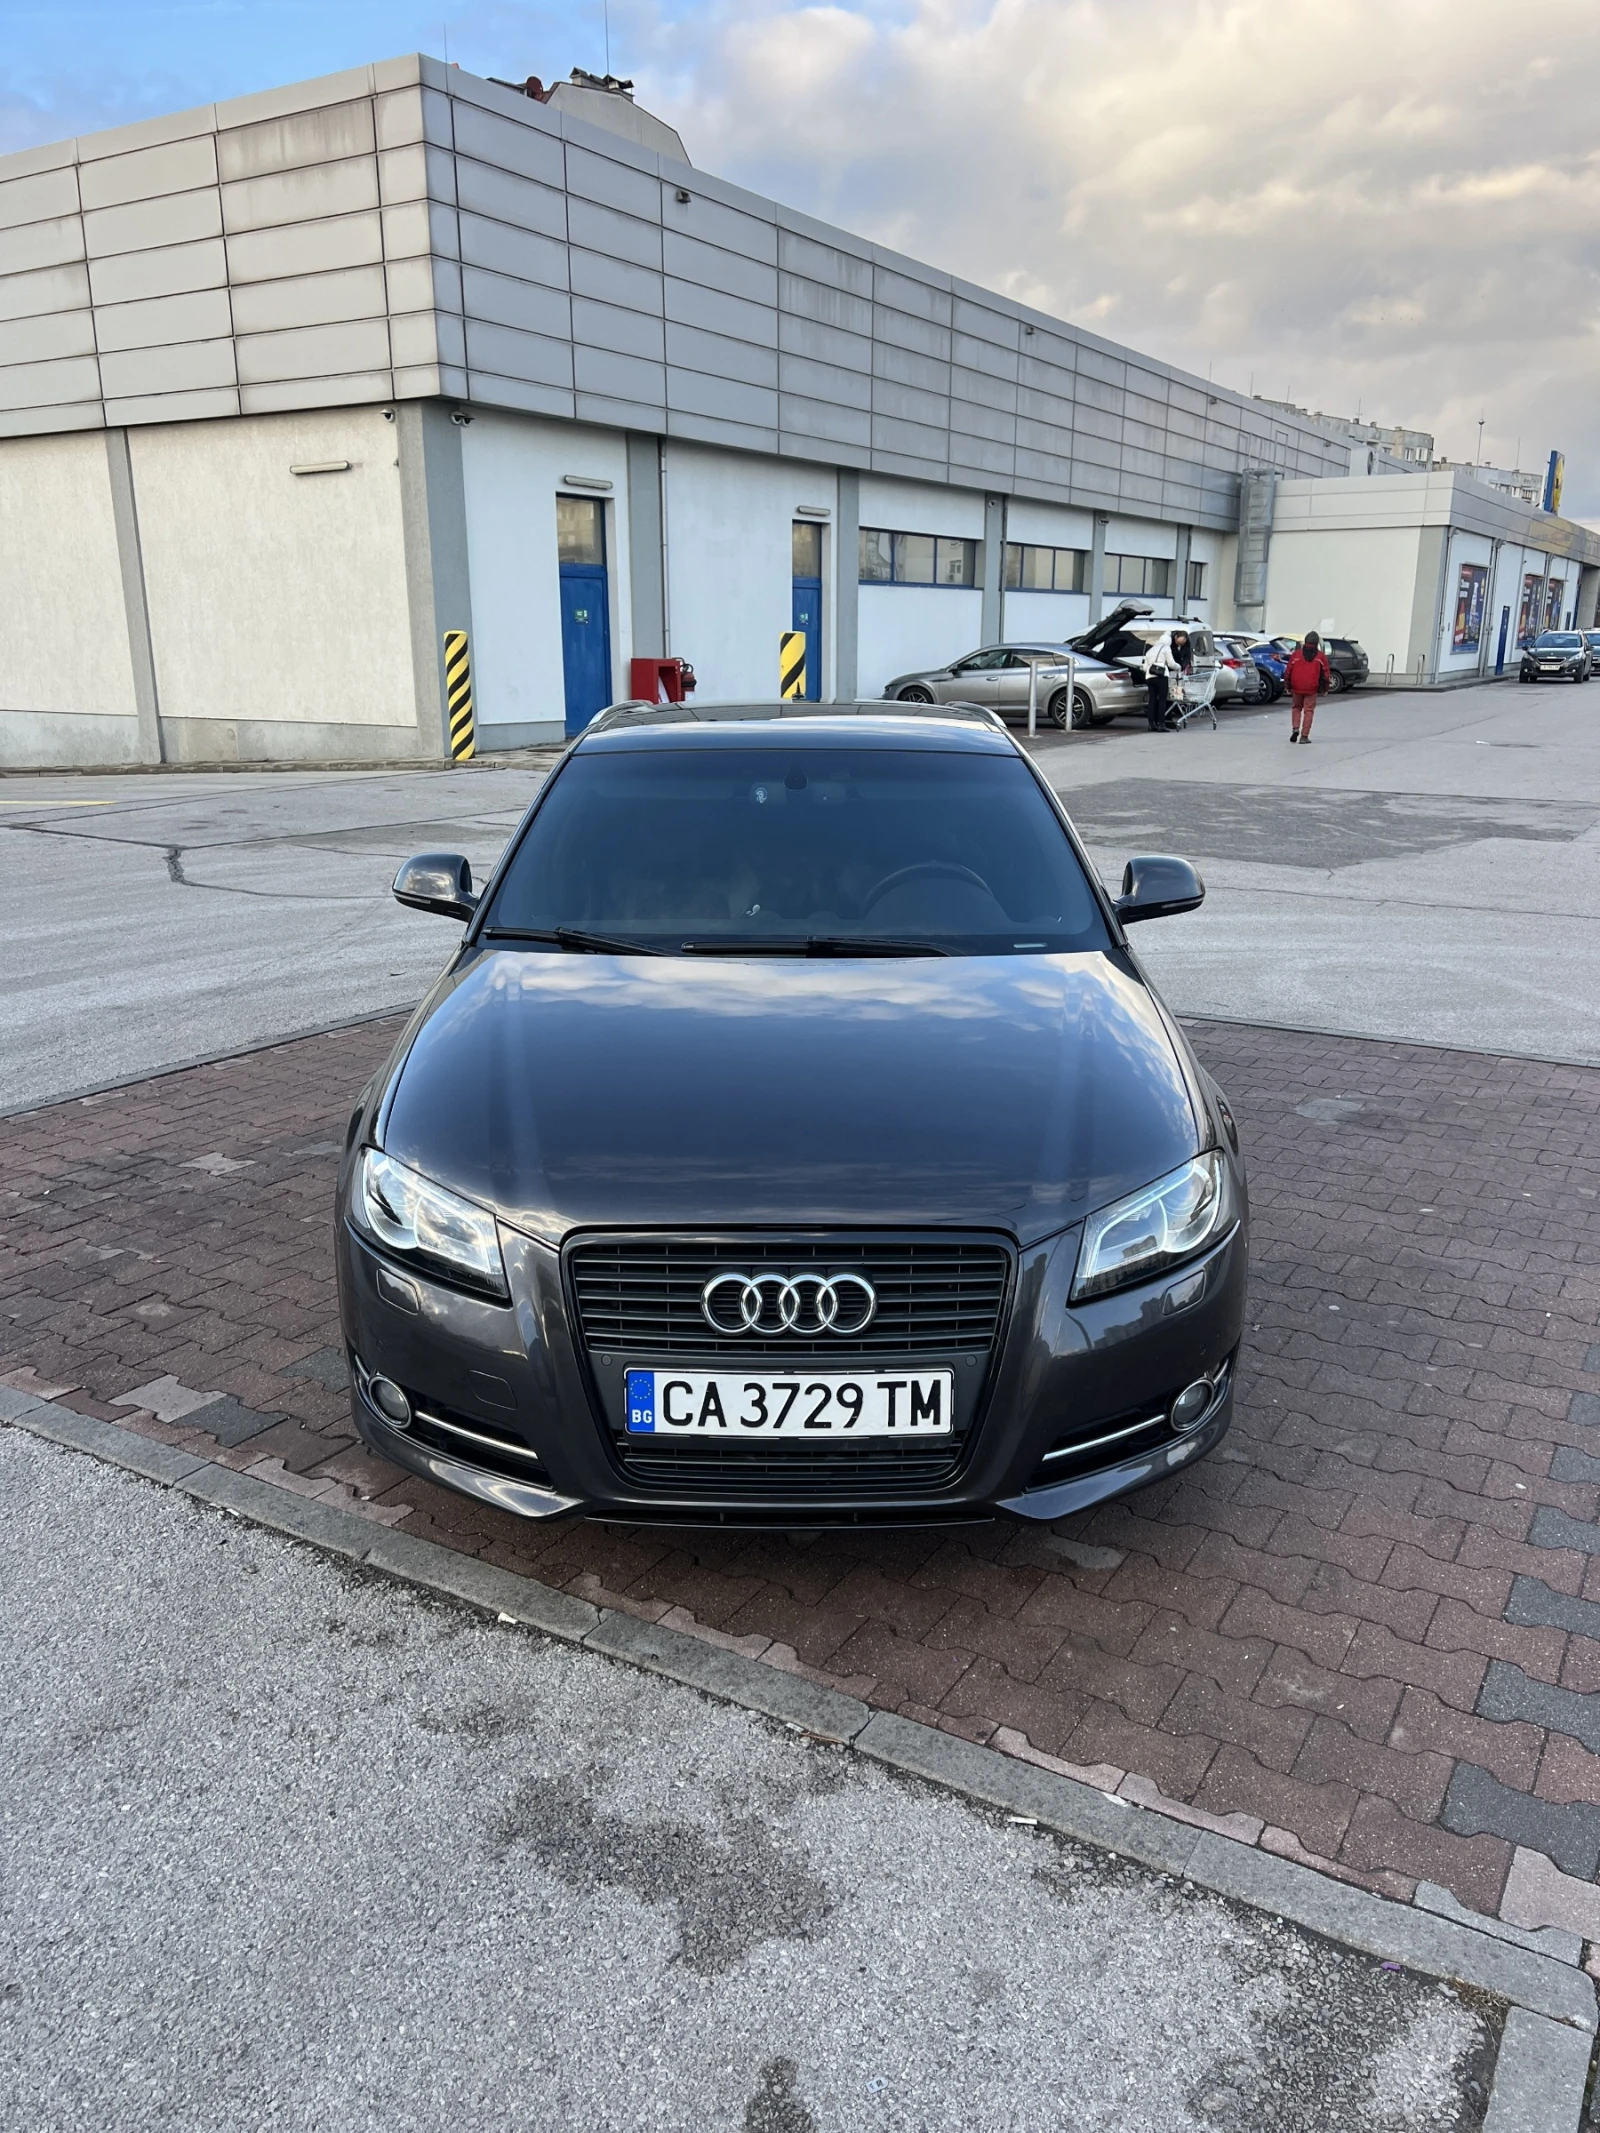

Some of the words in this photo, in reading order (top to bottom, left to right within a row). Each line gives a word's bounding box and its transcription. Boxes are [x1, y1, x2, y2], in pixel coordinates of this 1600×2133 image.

[632, 1409, 653, 1424] BG
[663, 1380, 727, 1427] CA
[740, 1382, 864, 1429] 3729
[877, 1379, 941, 1427] TM
